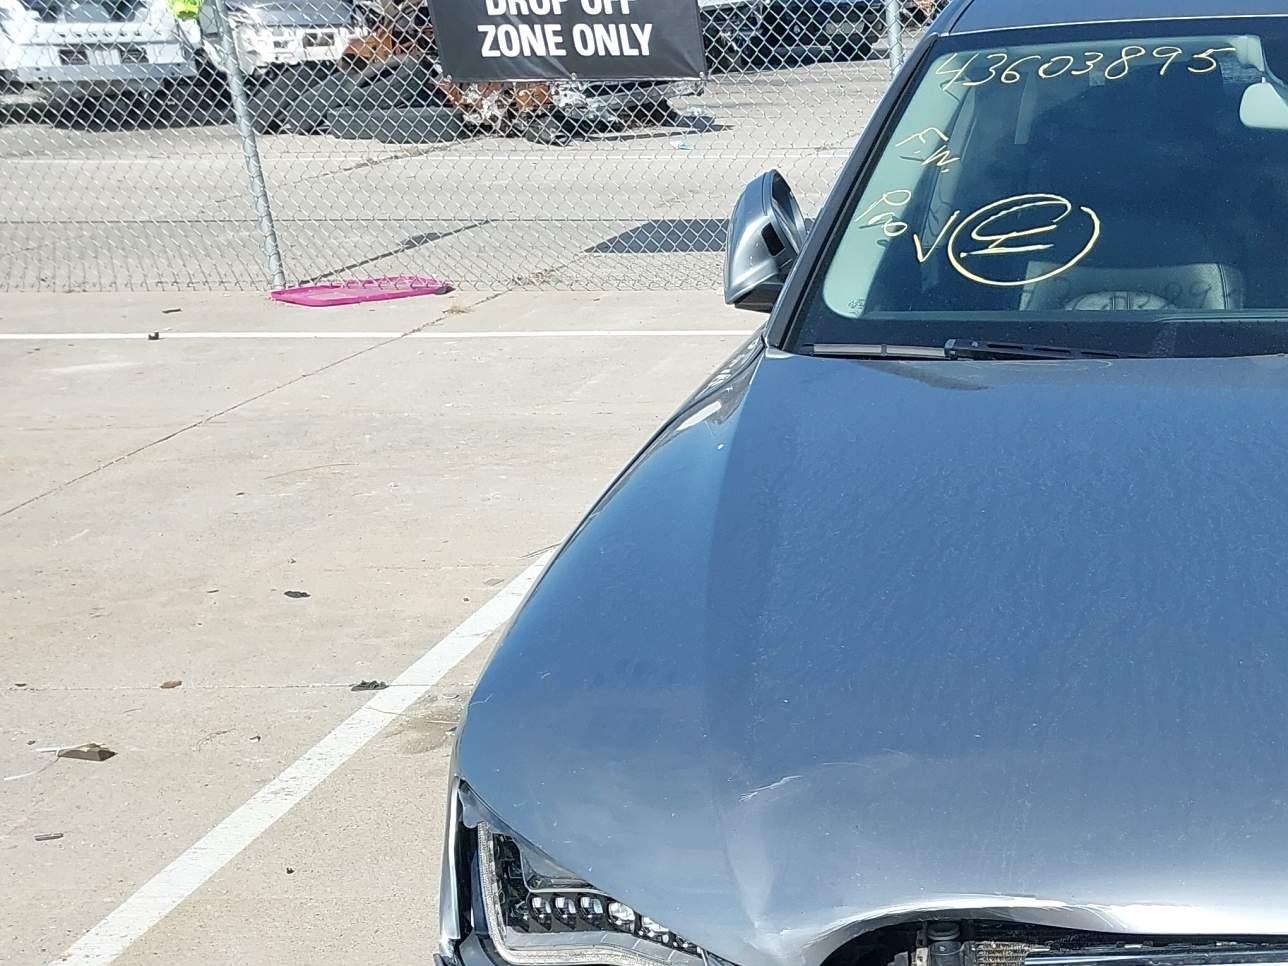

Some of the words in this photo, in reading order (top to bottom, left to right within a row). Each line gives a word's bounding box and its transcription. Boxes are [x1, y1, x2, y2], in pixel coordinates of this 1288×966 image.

[478, 24, 566, 57] ZONE
[573, 24, 652, 56] ONLY
[935, 45, 1236, 91] 43603895
